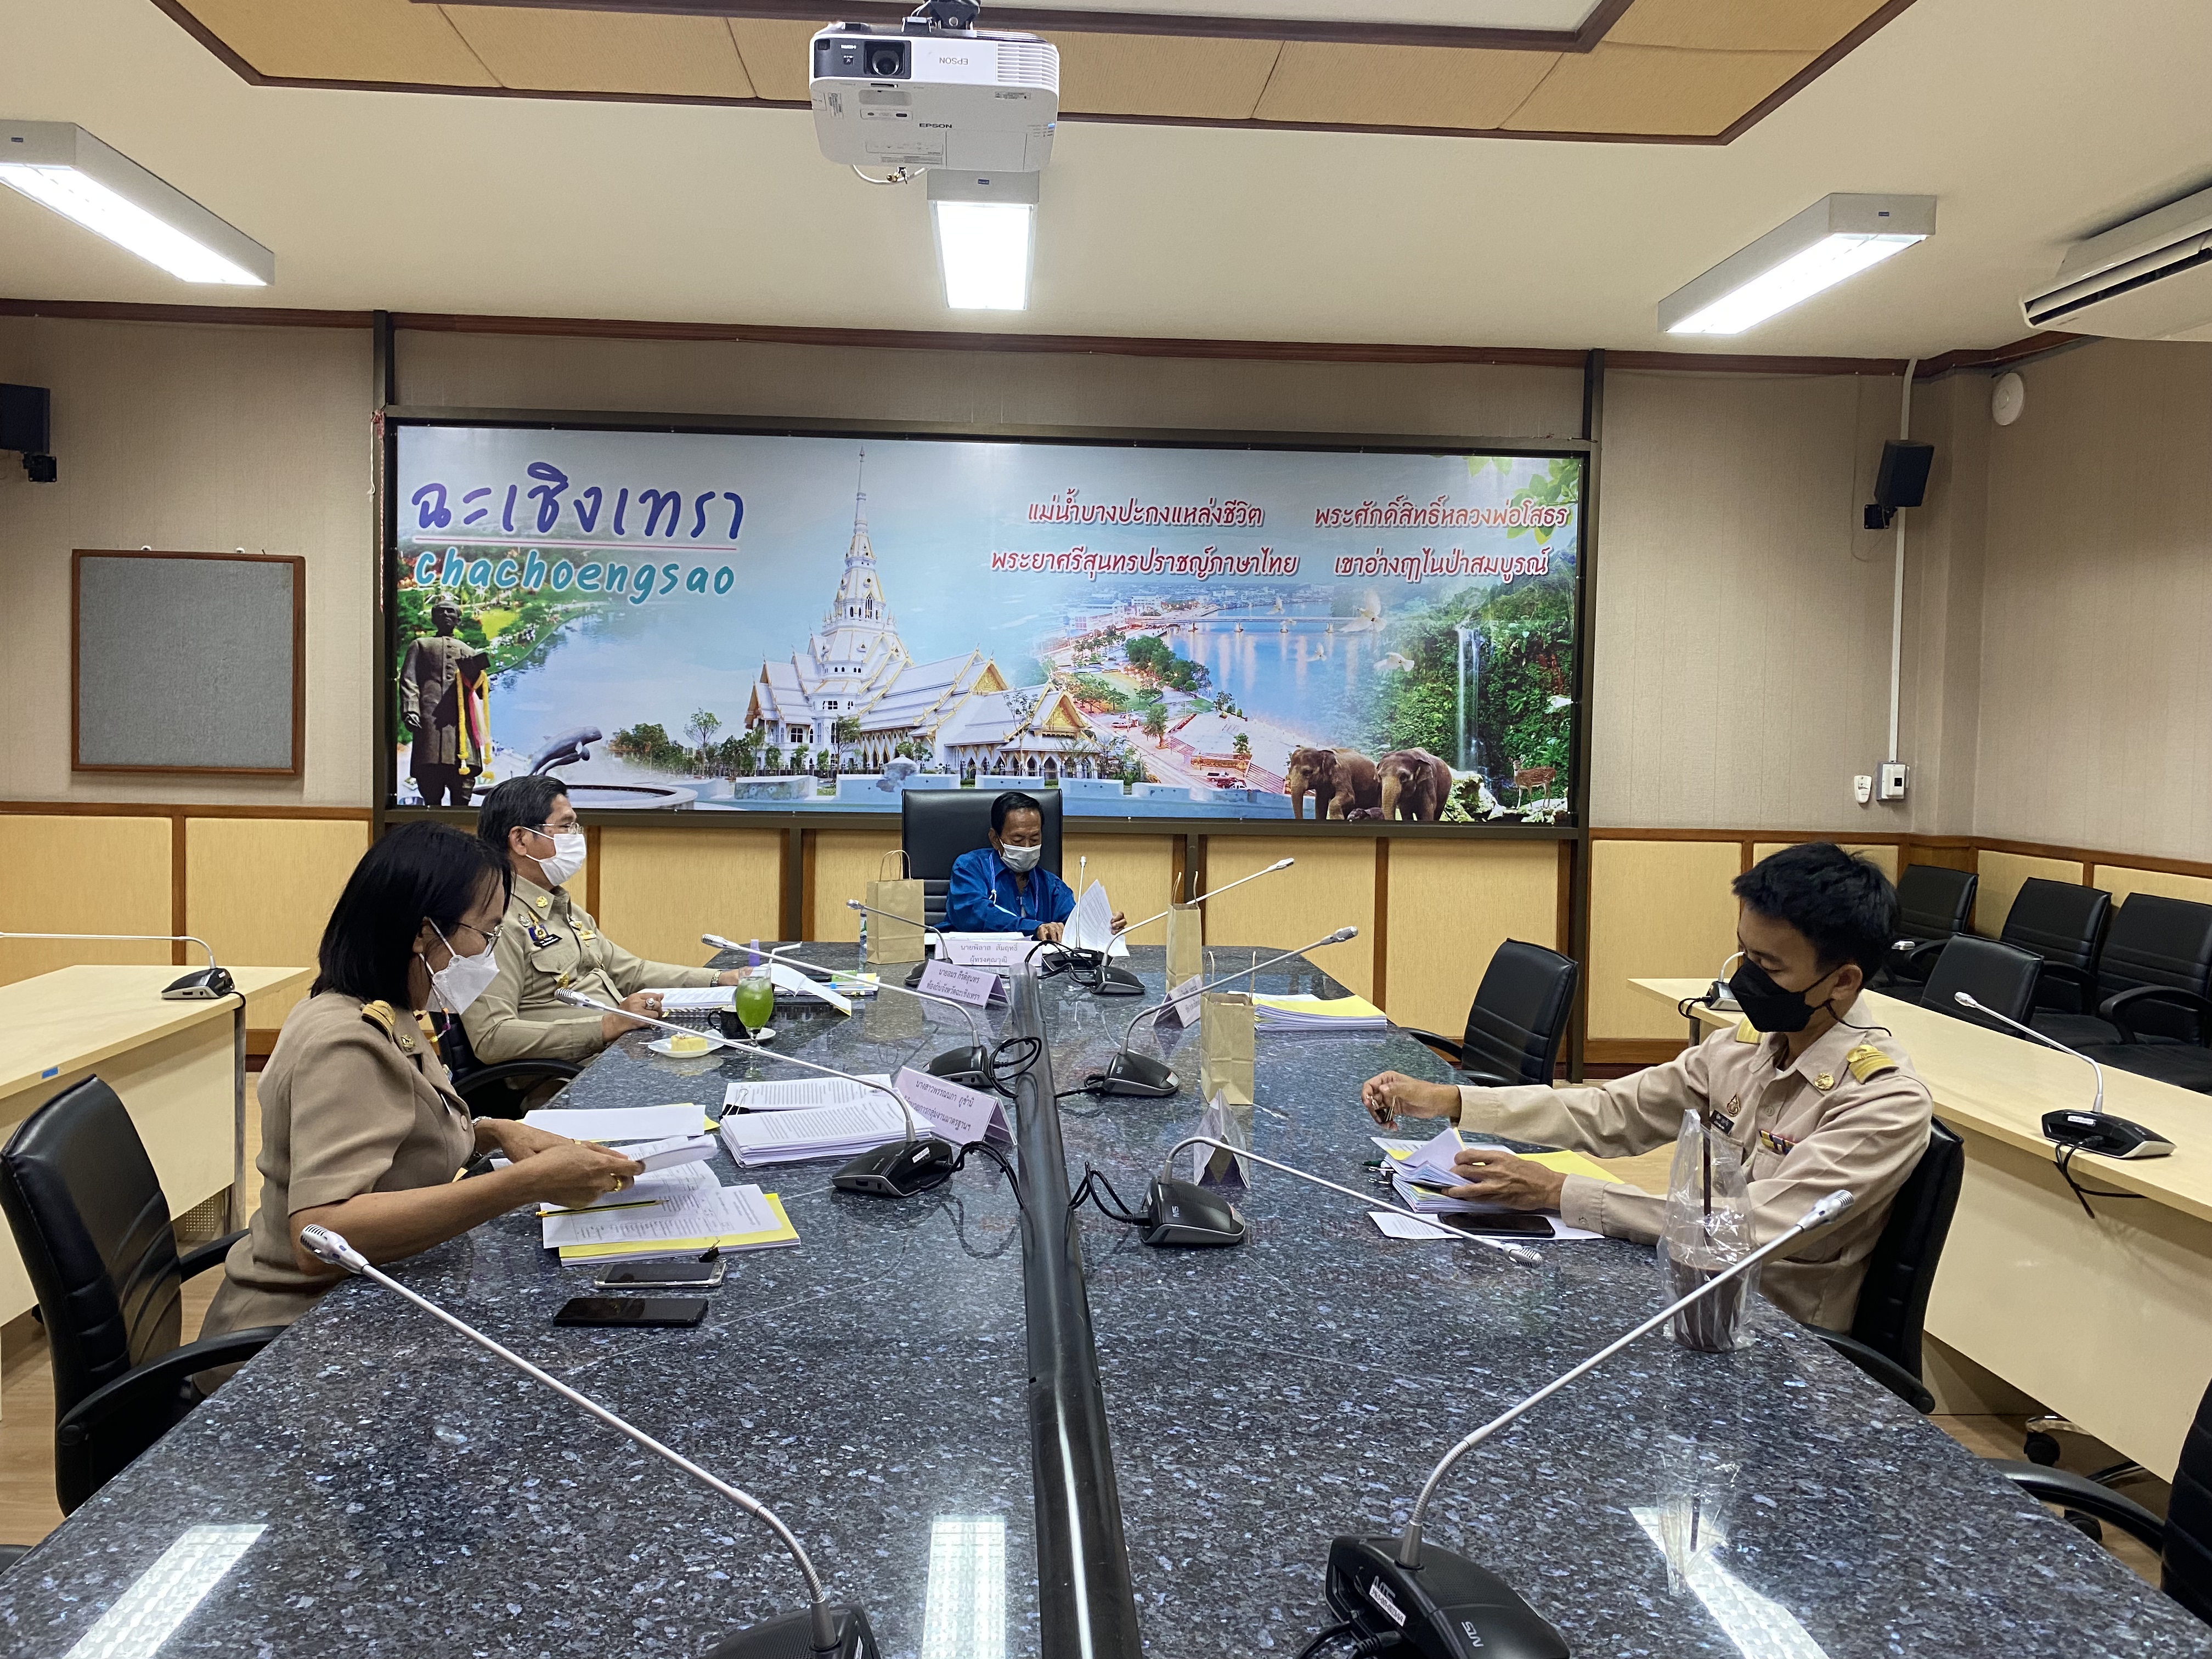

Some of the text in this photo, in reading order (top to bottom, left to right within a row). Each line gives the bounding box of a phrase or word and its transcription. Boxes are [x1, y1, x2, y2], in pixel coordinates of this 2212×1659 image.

[411, 461, 743, 539] ฉะเชิงเทรา
[1028, 488, 1568, 526] แม่น้ำบางปะกงแหล่งชีวิต พระศักดิ์สิทธิ์หลวงพ่อโสธร
[414, 547, 735, 604] Chachoengsao
[991, 546, 1297, 579] พระยาศรีสุนทรปราชญ์ภาษาไทย
